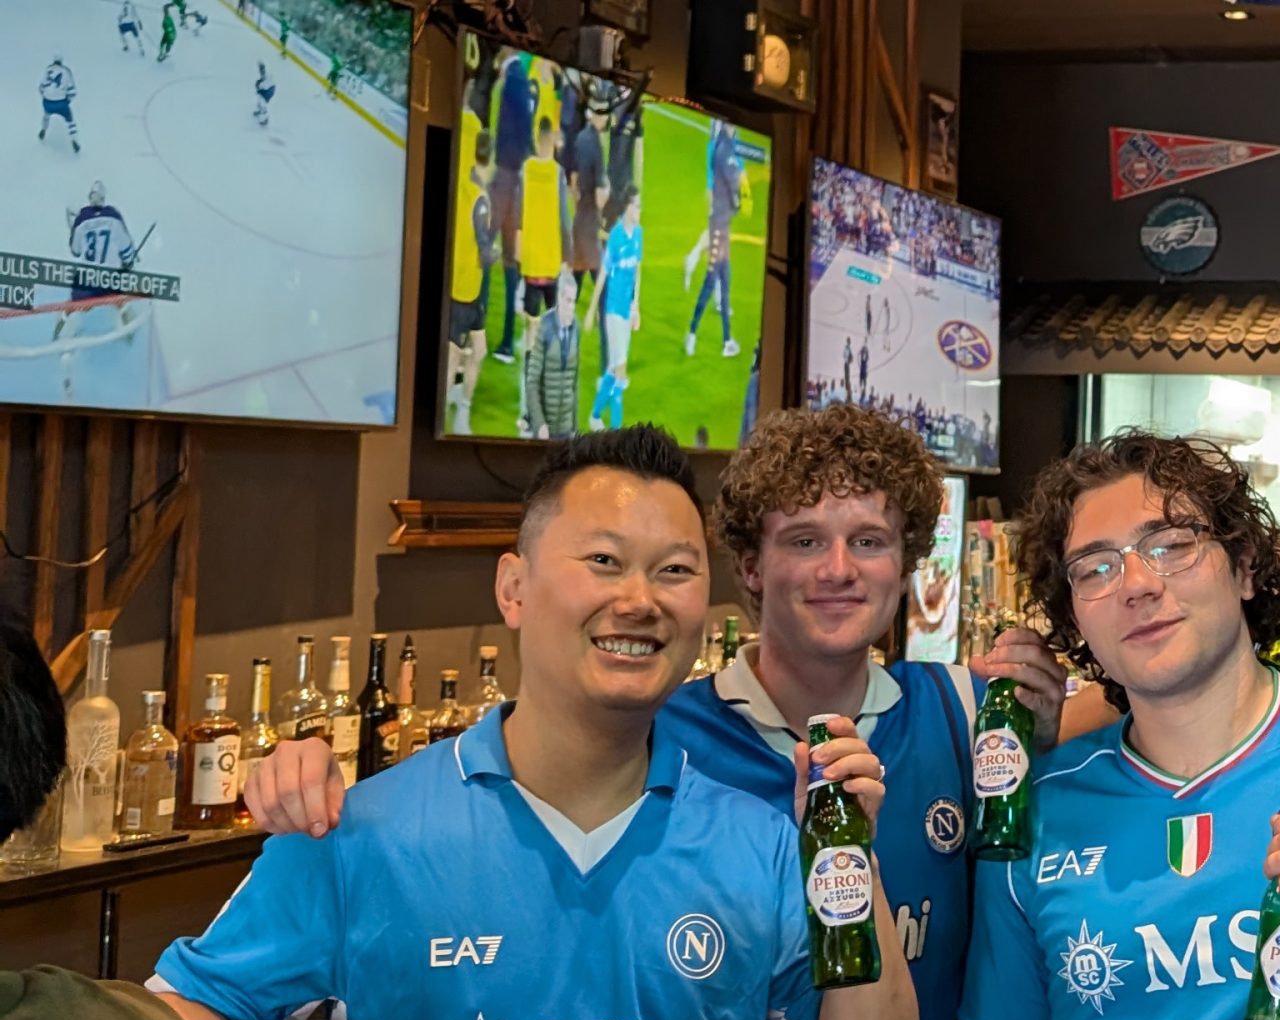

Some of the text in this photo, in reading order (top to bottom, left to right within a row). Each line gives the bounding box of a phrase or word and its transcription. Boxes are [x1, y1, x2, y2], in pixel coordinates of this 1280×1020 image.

[85, 229, 112, 264] 37
[0, 256, 181, 297] ULLS THE TRIGGER OFF A
[0, 284, 35, 306] TICK
[218, 752, 236, 775] Q
[975, 752, 1021, 771] PERONI
[221, 780, 232, 798] 7
[935, 812, 954, 837] N
[1037, 845, 1108, 884] EA7
[813, 872, 870, 893] PERONI
[429, 935, 503, 968] EA7
[681, 929, 711, 962] N
